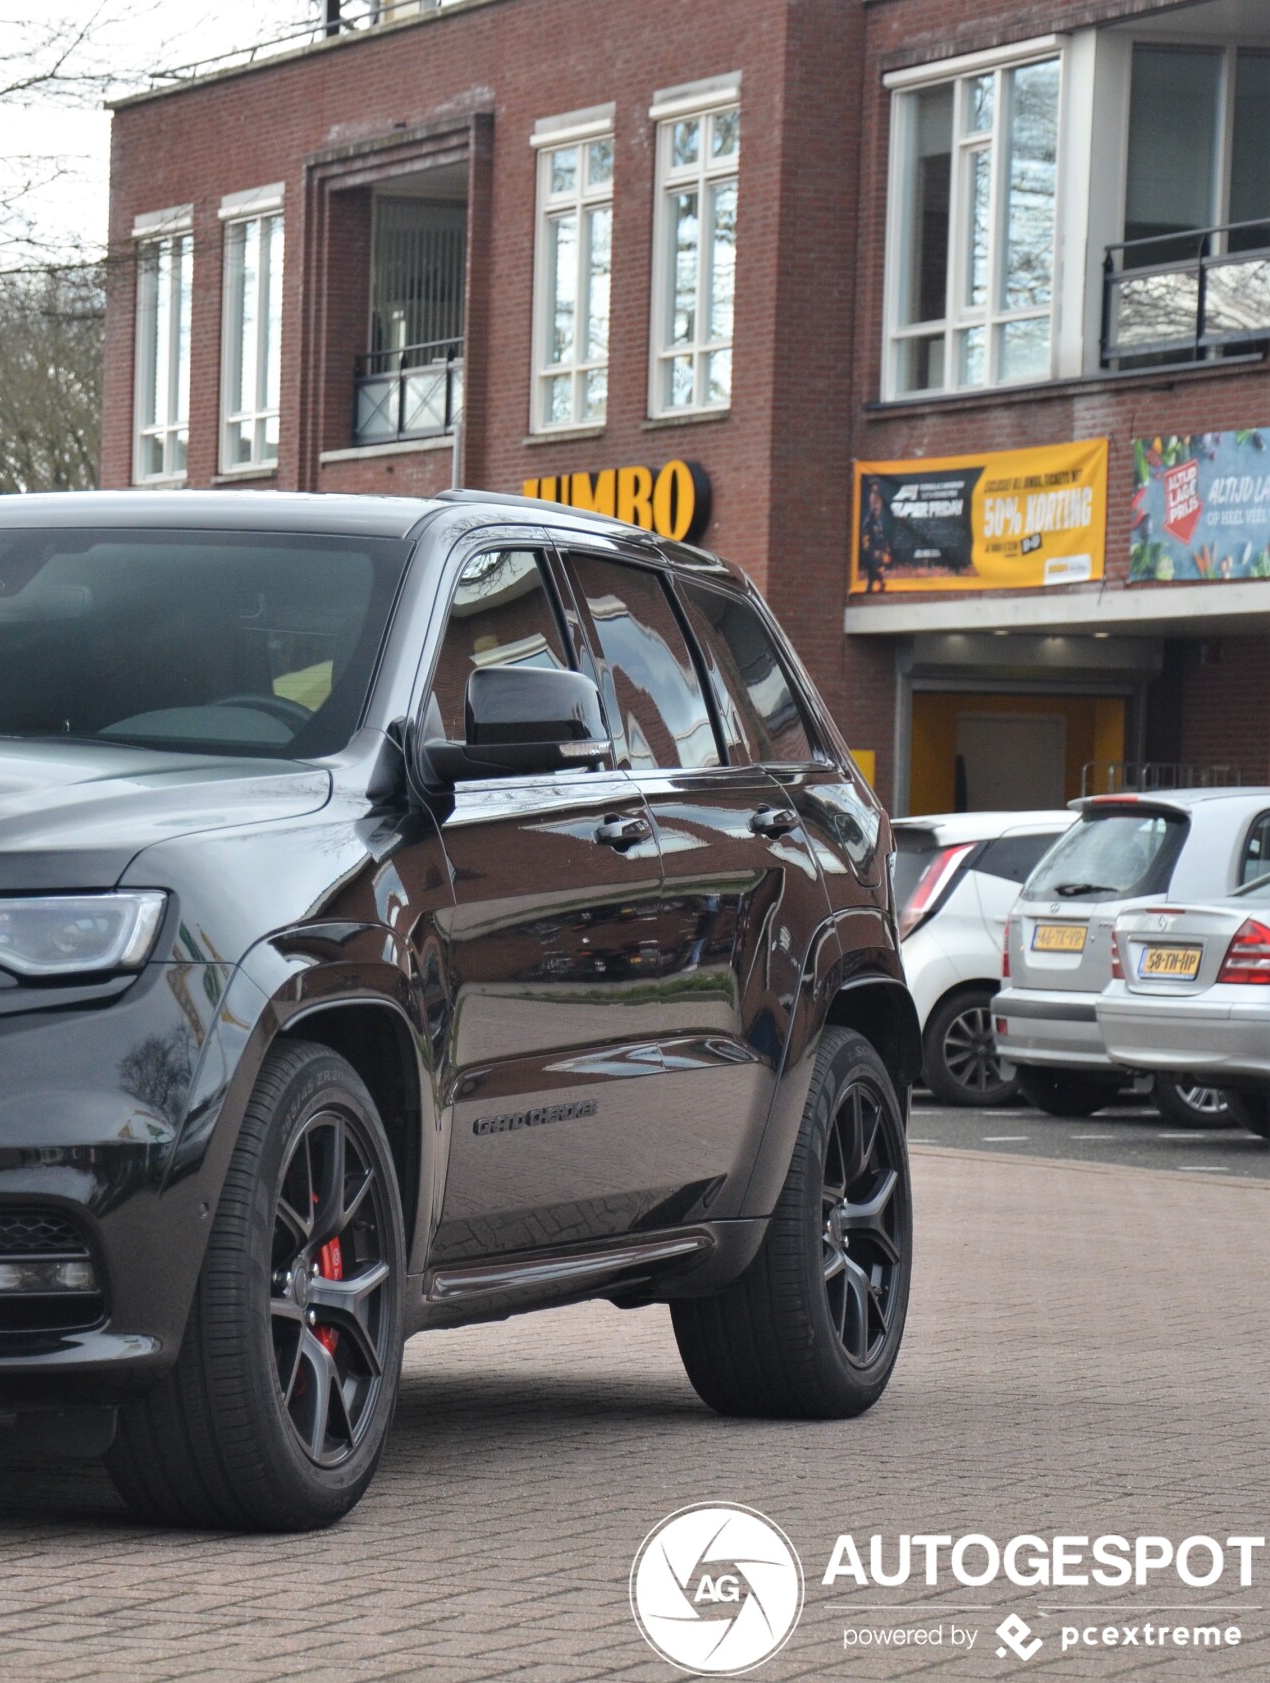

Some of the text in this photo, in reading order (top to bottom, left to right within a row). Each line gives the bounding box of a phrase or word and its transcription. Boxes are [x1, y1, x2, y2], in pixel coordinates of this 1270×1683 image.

[1209, 475, 1254, 504] ALTIJD
[984, 496, 1022, 538] 50%
[1024, 486, 1092, 534] KORTING
[473, 1112, 526, 1135] GRAND
